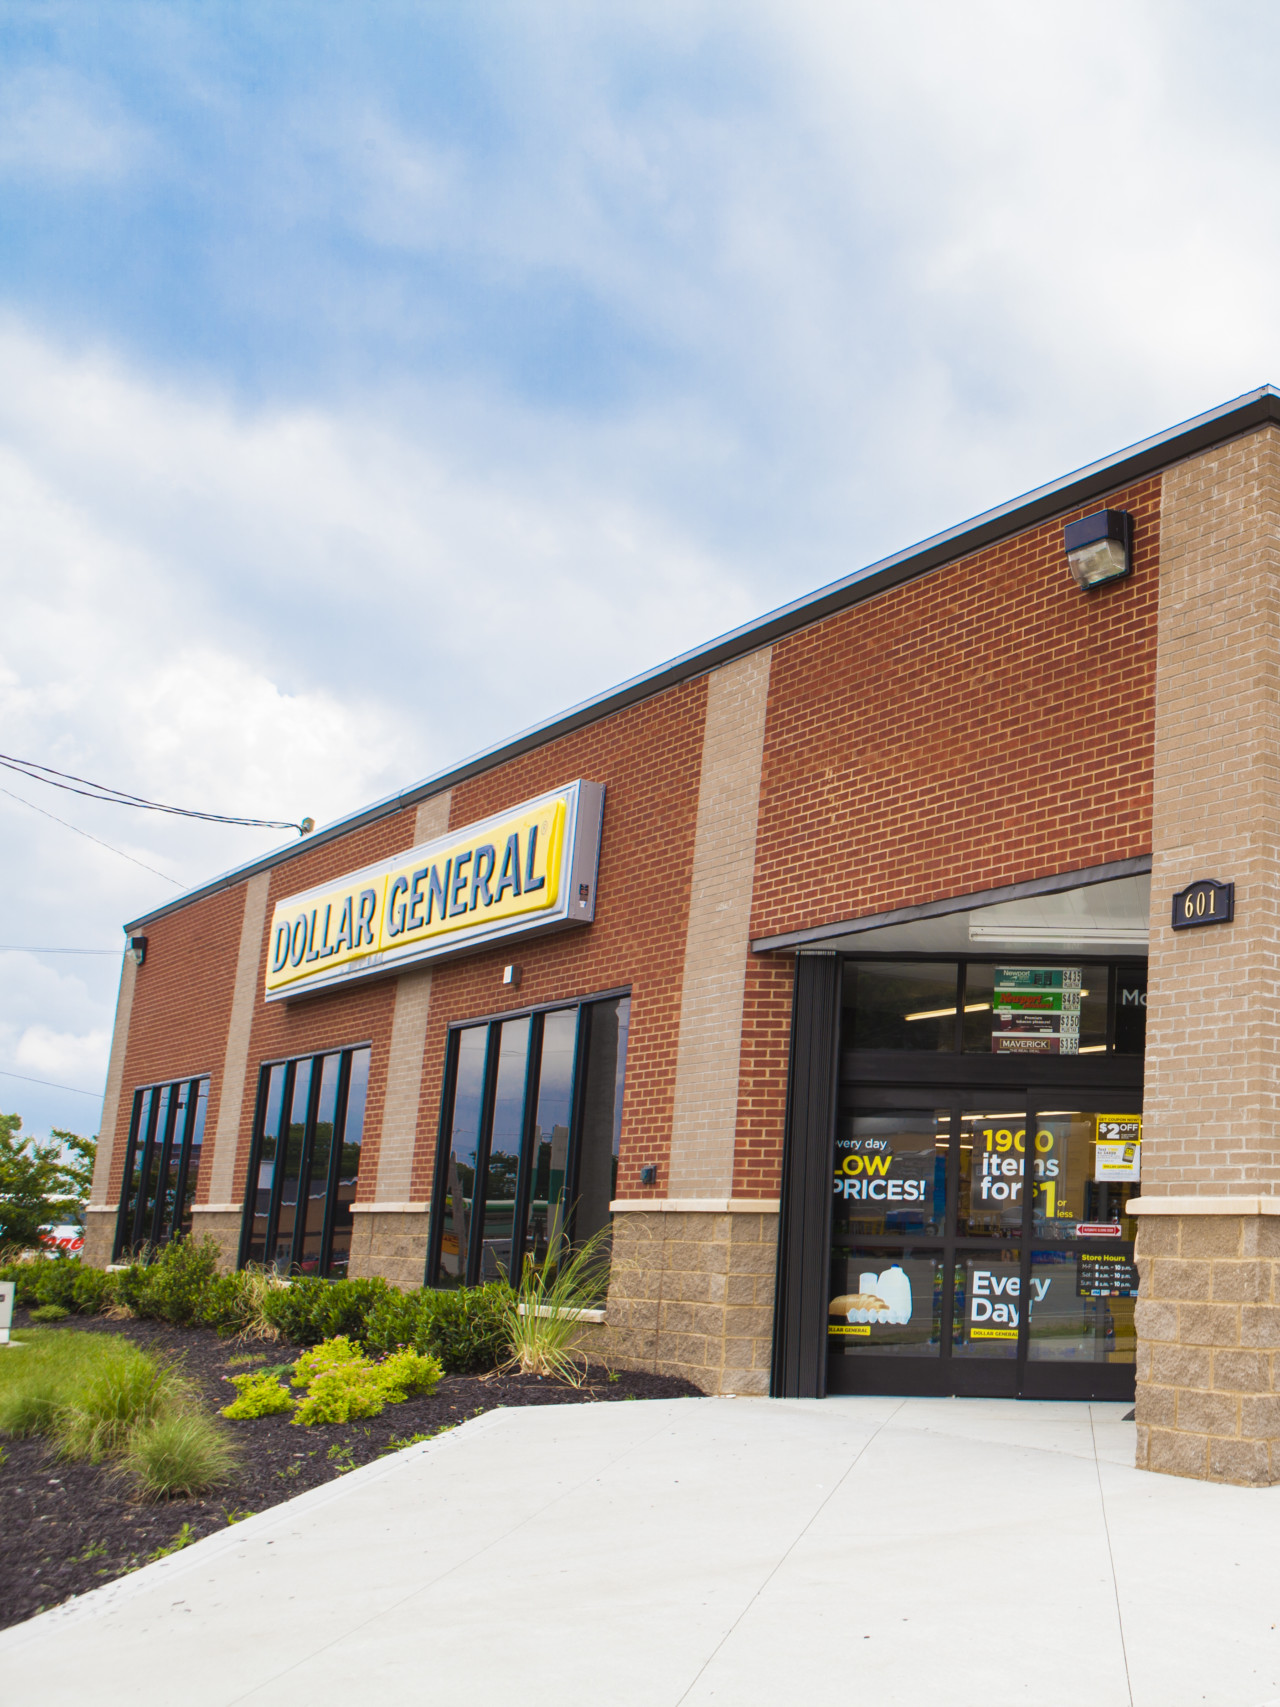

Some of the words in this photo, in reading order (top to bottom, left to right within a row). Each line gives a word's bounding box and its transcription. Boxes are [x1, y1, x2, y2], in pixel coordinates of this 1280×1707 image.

[272, 888, 377, 973] DOLLAR
[386, 824, 545, 938] GENERAL
[1184, 889, 1216, 918] 601
[1002, 1040, 1047, 1048] MAVERICK
[983, 1130, 1054, 1152] 1900
[1099, 1122, 1120, 1139] $2
[1120, 1123, 1138, 1131] OFF
[834, 1140, 862, 1151] very
[865, 1139, 887, 1150] day
[982, 1152, 1060, 1177] items
[981, 1176, 1022, 1200] for
[1057, 1209, 1074, 1218] less
